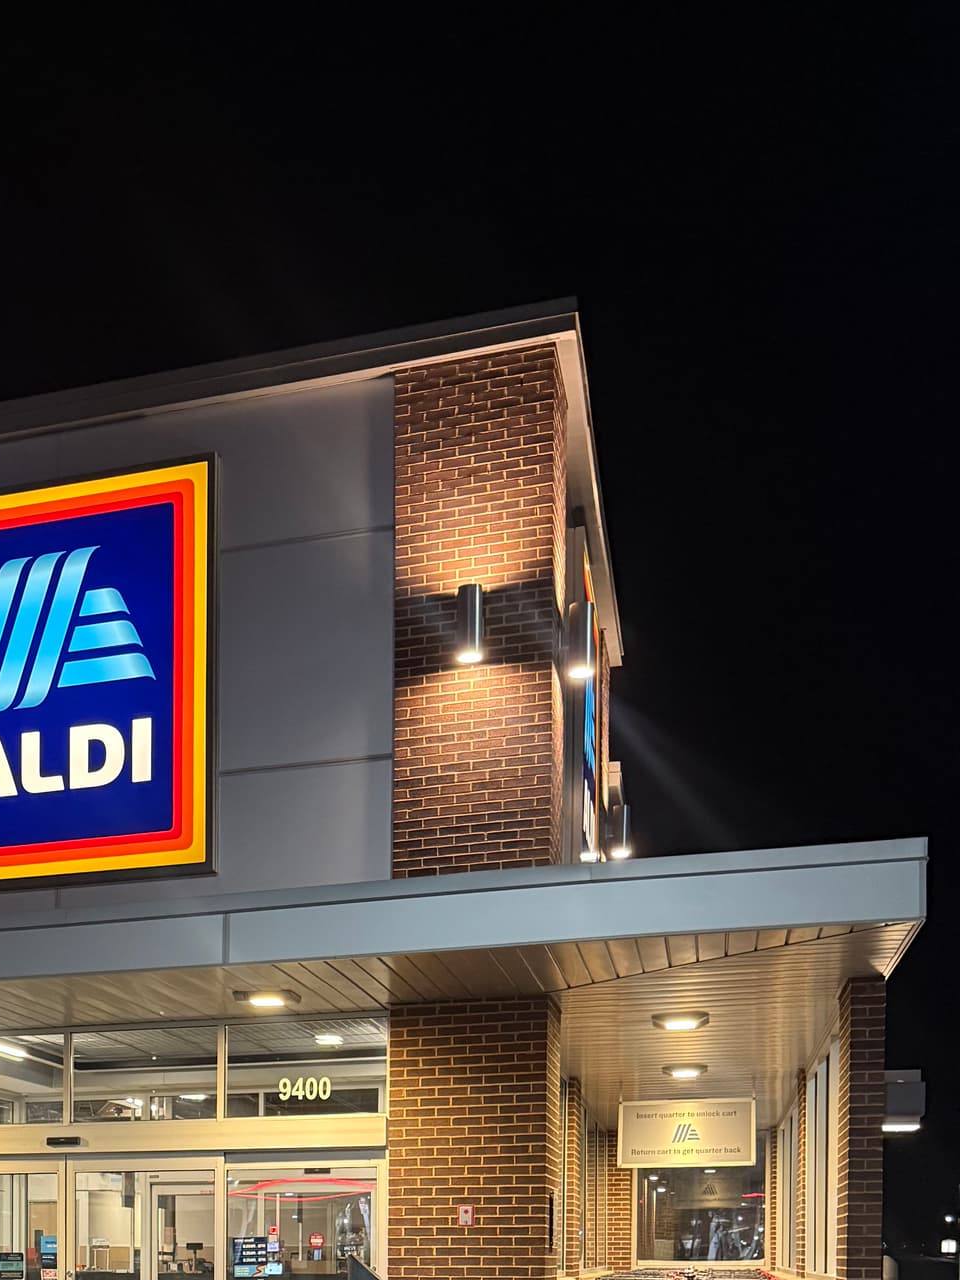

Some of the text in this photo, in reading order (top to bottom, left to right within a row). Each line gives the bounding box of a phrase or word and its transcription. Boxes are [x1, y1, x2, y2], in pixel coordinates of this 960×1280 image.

[278, 1076, 332, 1101] 9400
[636, 1112, 658, 1120] Insert
[659, 1111, 686, 1120] quarter
[696, 1110, 721, 1118] unlock
[631, 1148, 656, 1156] Return
[682, 1148, 694, 1156] get
[695, 1147, 722, 1155] quarter
[724, 1146, 741, 1154] back
